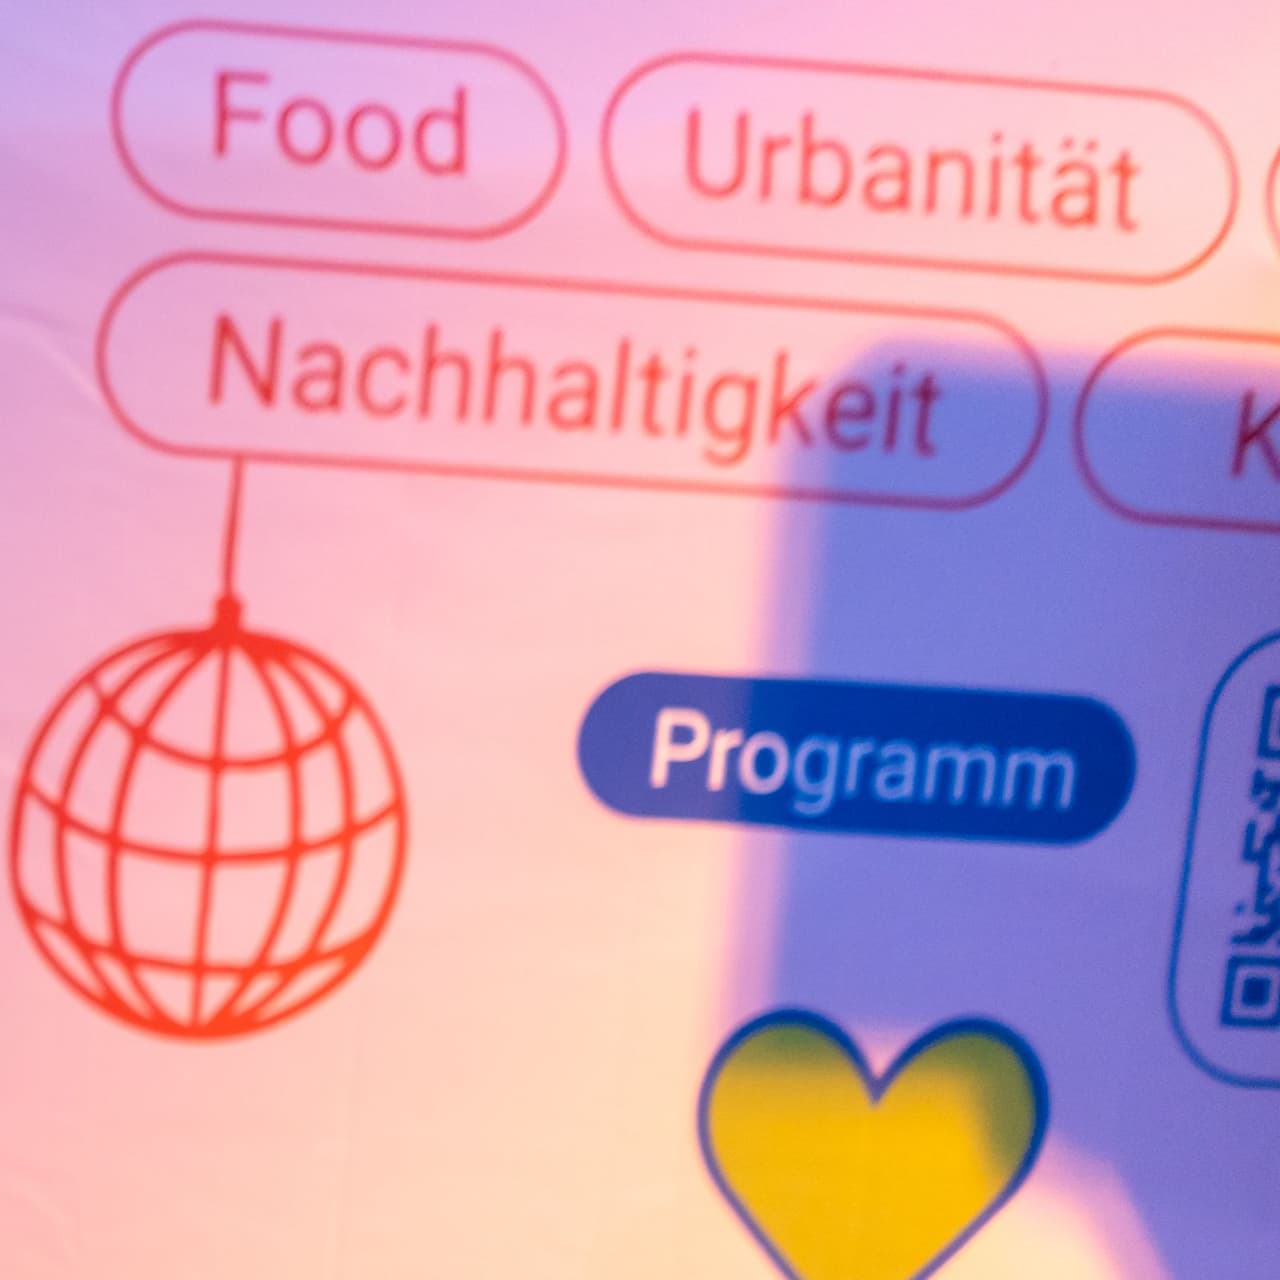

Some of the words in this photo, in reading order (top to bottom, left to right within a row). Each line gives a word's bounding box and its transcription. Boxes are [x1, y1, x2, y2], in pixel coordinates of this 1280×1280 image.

[211, 70, 469, 177] Food
[683, 105, 1143, 233] Urbanität
[207, 312, 944, 467] Nachhaltigkeit
[650, 707, 1077, 816] Programm
